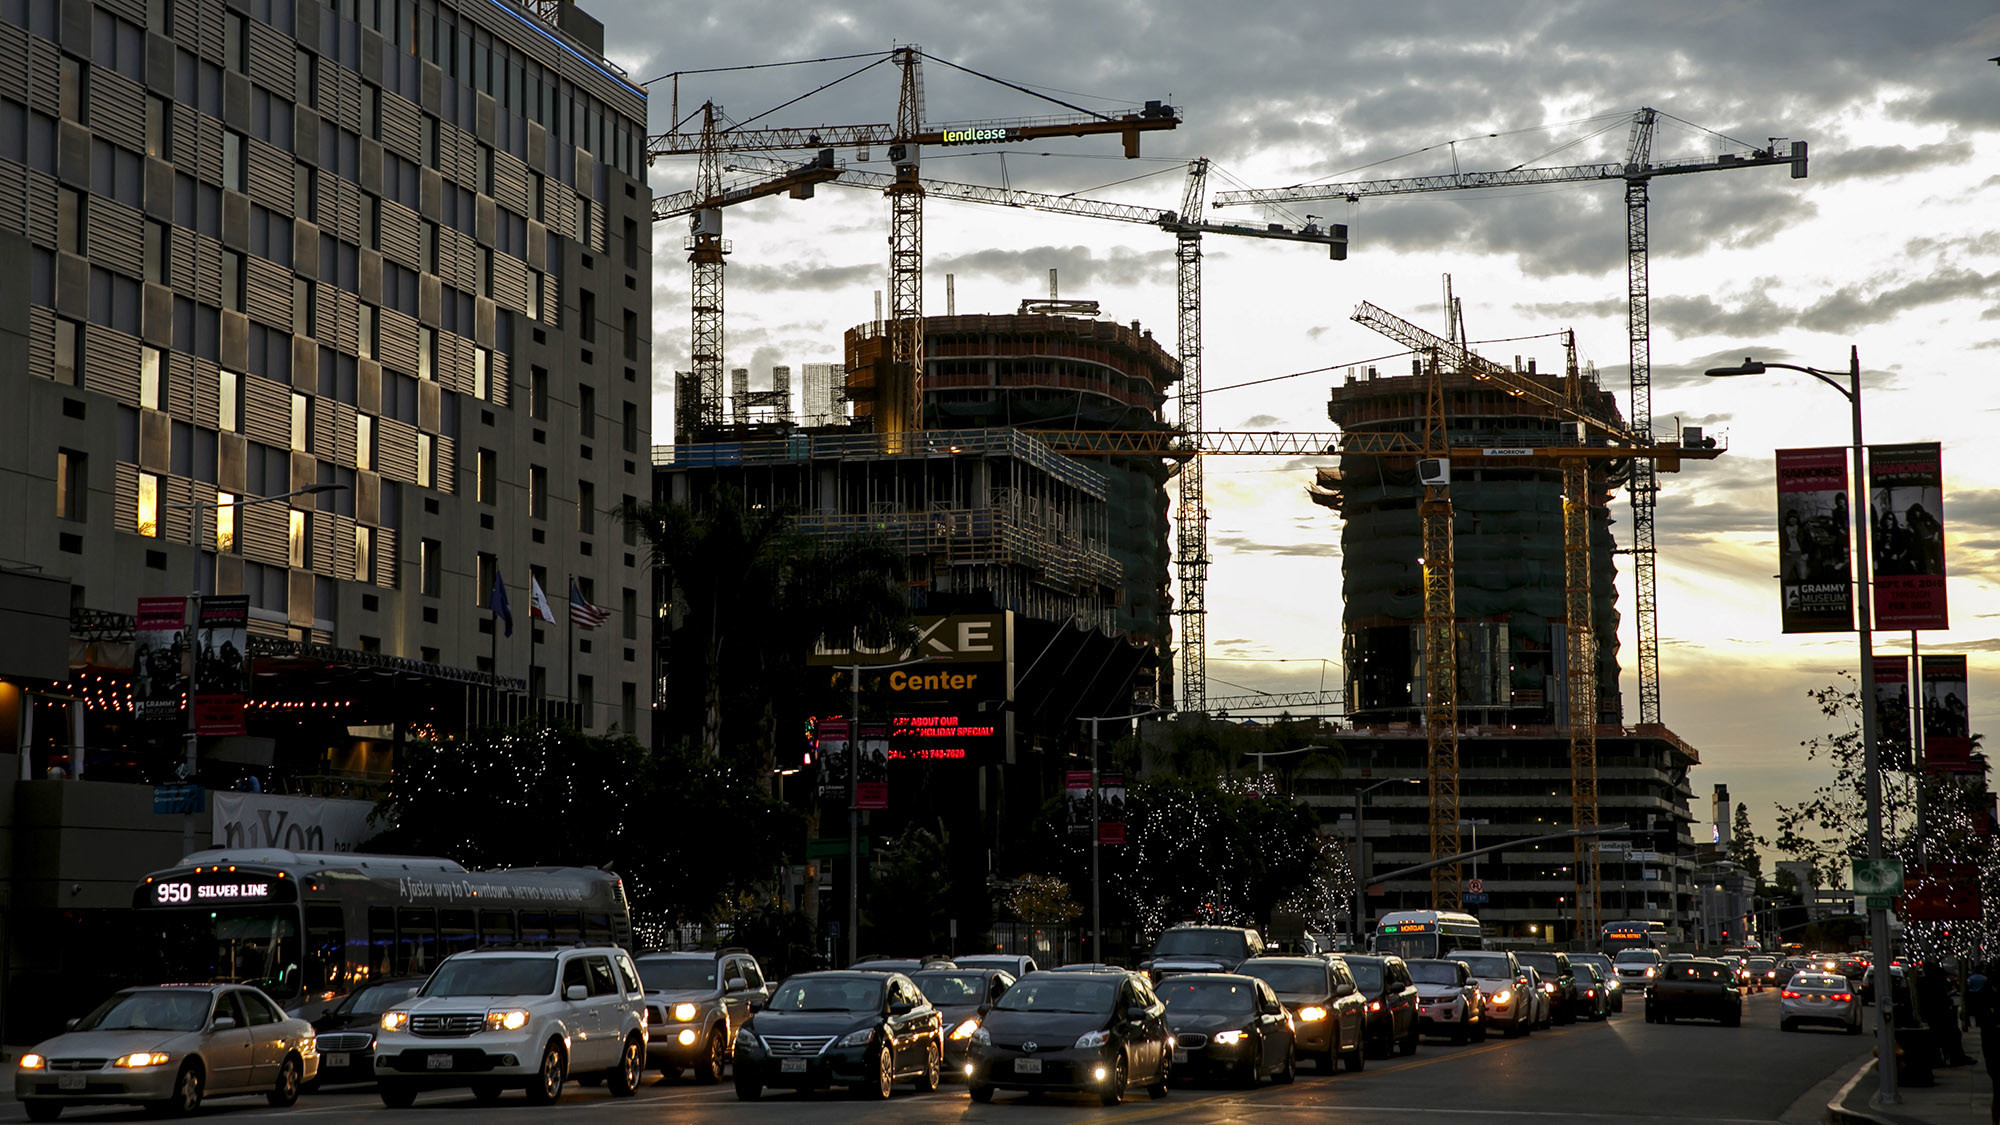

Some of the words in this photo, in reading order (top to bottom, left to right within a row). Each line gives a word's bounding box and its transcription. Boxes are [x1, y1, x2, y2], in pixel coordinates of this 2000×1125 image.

[943, 127, 1006, 142] lendlease
[1781, 467, 1842, 478] RAMONES
[1872, 462, 1936, 475] RAMONES
[1801, 584, 1846, 593] GRAMMY
[889, 671, 977, 691] Center
[911, 717, 939, 726] ABOUT
[940, 716, 958, 726] OUR
[957, 726, 994, 736] SPECIAL!
[158, 883, 193, 902] 950
[198, 884, 239, 898] SILVER
[240, 884, 268, 896] LINE
[400, 879, 407, 896] A
[408, 876, 432, 903] faster
[434, 883, 453, 903] way
